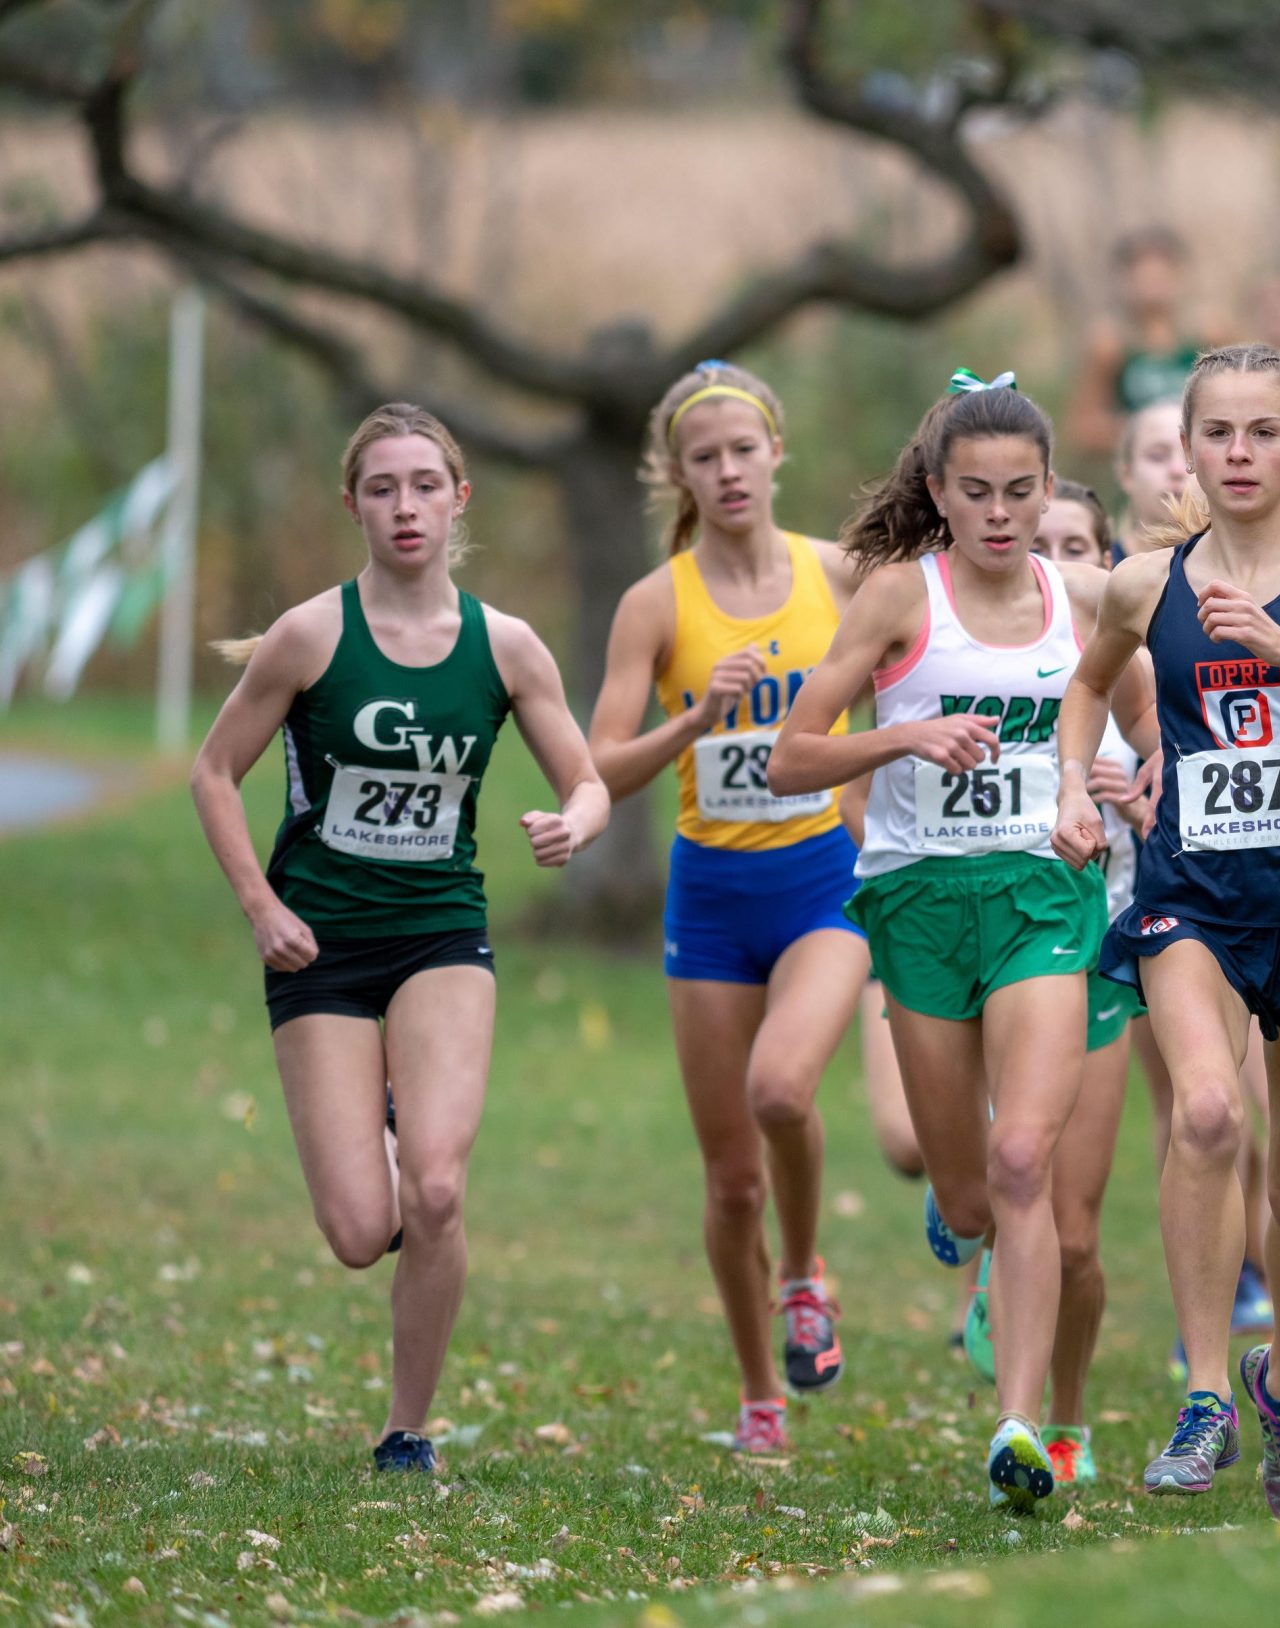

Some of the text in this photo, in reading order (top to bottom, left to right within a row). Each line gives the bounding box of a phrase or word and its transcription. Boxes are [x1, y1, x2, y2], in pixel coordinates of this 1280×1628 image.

[1209, 664, 1270, 687] OPRF
[353, 699, 477, 775] GW
[354, 781, 441, 829] 273
[941, 768, 1021, 818] 251
[332, 824, 449, 846] LAKESHORE
[924, 823, 1049, 837] LAKESHORE
